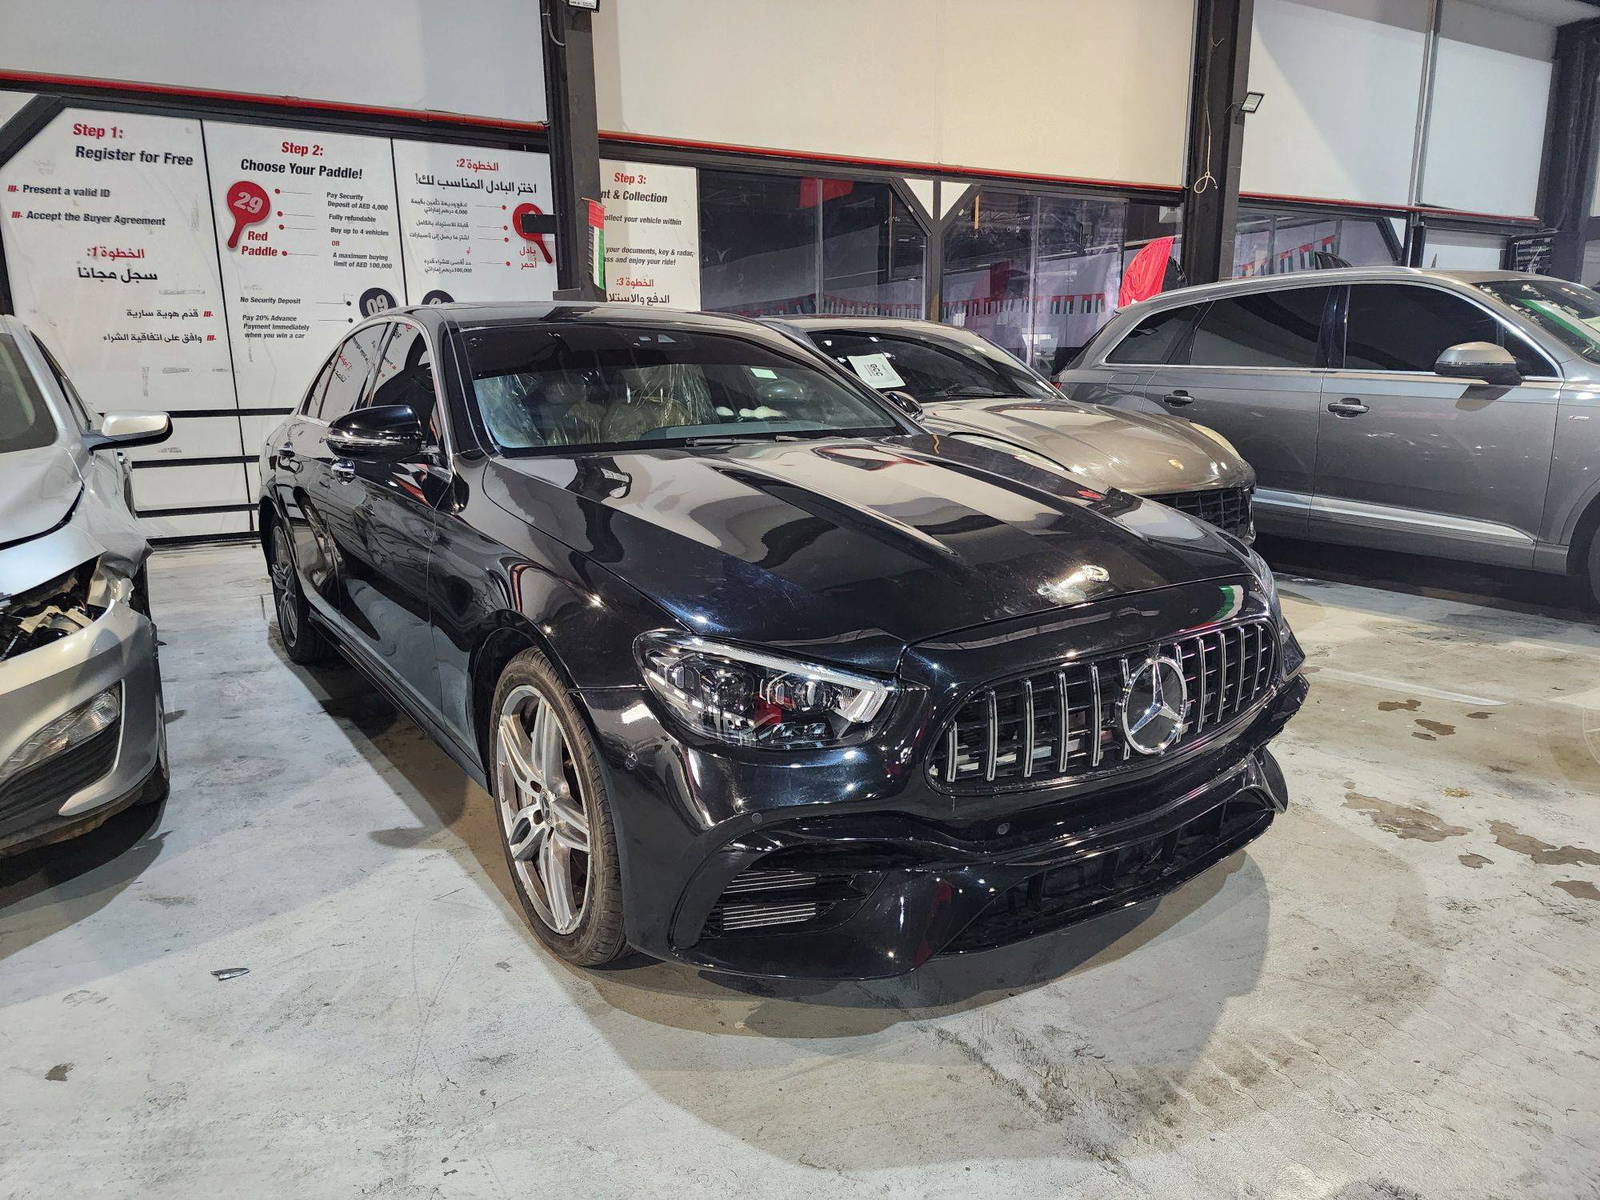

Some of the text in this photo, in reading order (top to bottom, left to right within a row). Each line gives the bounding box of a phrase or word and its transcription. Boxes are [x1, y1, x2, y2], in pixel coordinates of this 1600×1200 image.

[73, 123, 123, 139] Step 1:
[281, 141, 324, 157] Step 2:
[75, 146, 193, 166] Register for Free
[241, 159, 363, 180] Choose Your Paddle!
[467, 159, 499, 172] الخطوة
[437, 178, 484, 190] المناسب
[614, 172, 647, 185] Step 3:
[22, 185, 61, 195] Present
[73, 187, 97, 197] valid
[100, 189, 111, 197] ID
[486, 180, 515, 196] البادل
[517, 182, 537, 196] اختر
[339, 193, 363, 201] Security
[613, 190, 620, 200] &
[623, 190, 668, 203] Collection
[234, 192, 263, 214] 29
[26, 211, 166, 226] Accept the Buyer Agreement
[329, 213, 343, 221] Fully
[624, 216, 638, 224] your
[640, 217, 662, 225] vehicle
[662, 218, 682, 226] within
[248, 231, 268, 241] Red
[330, 227, 342, 235] Buy
[101, 246, 145, 261] الخطوة
[241, 246, 277, 257] Paddle
[520, 246, 536, 256] بادل
[622, 247, 657, 256] documents,
[369, 262, 393, 270] 100,000
[521, 257, 537, 270] أحمر
[626, 277, 654, 289] الخطوة
[250, 297, 276, 305] Security
[277, 297, 301, 305] Deposit
[366, 294, 389, 315] 09
[646, 292, 670, 306] الدفع
[126, 309, 154, 319] سارية
[157, 309, 179, 319] هوية
[242, 314, 254, 322] Pay
[243, 323, 310, 332] Payment Immediately
[103, 332, 203, 343] وافق على اتفاقية الشراء
